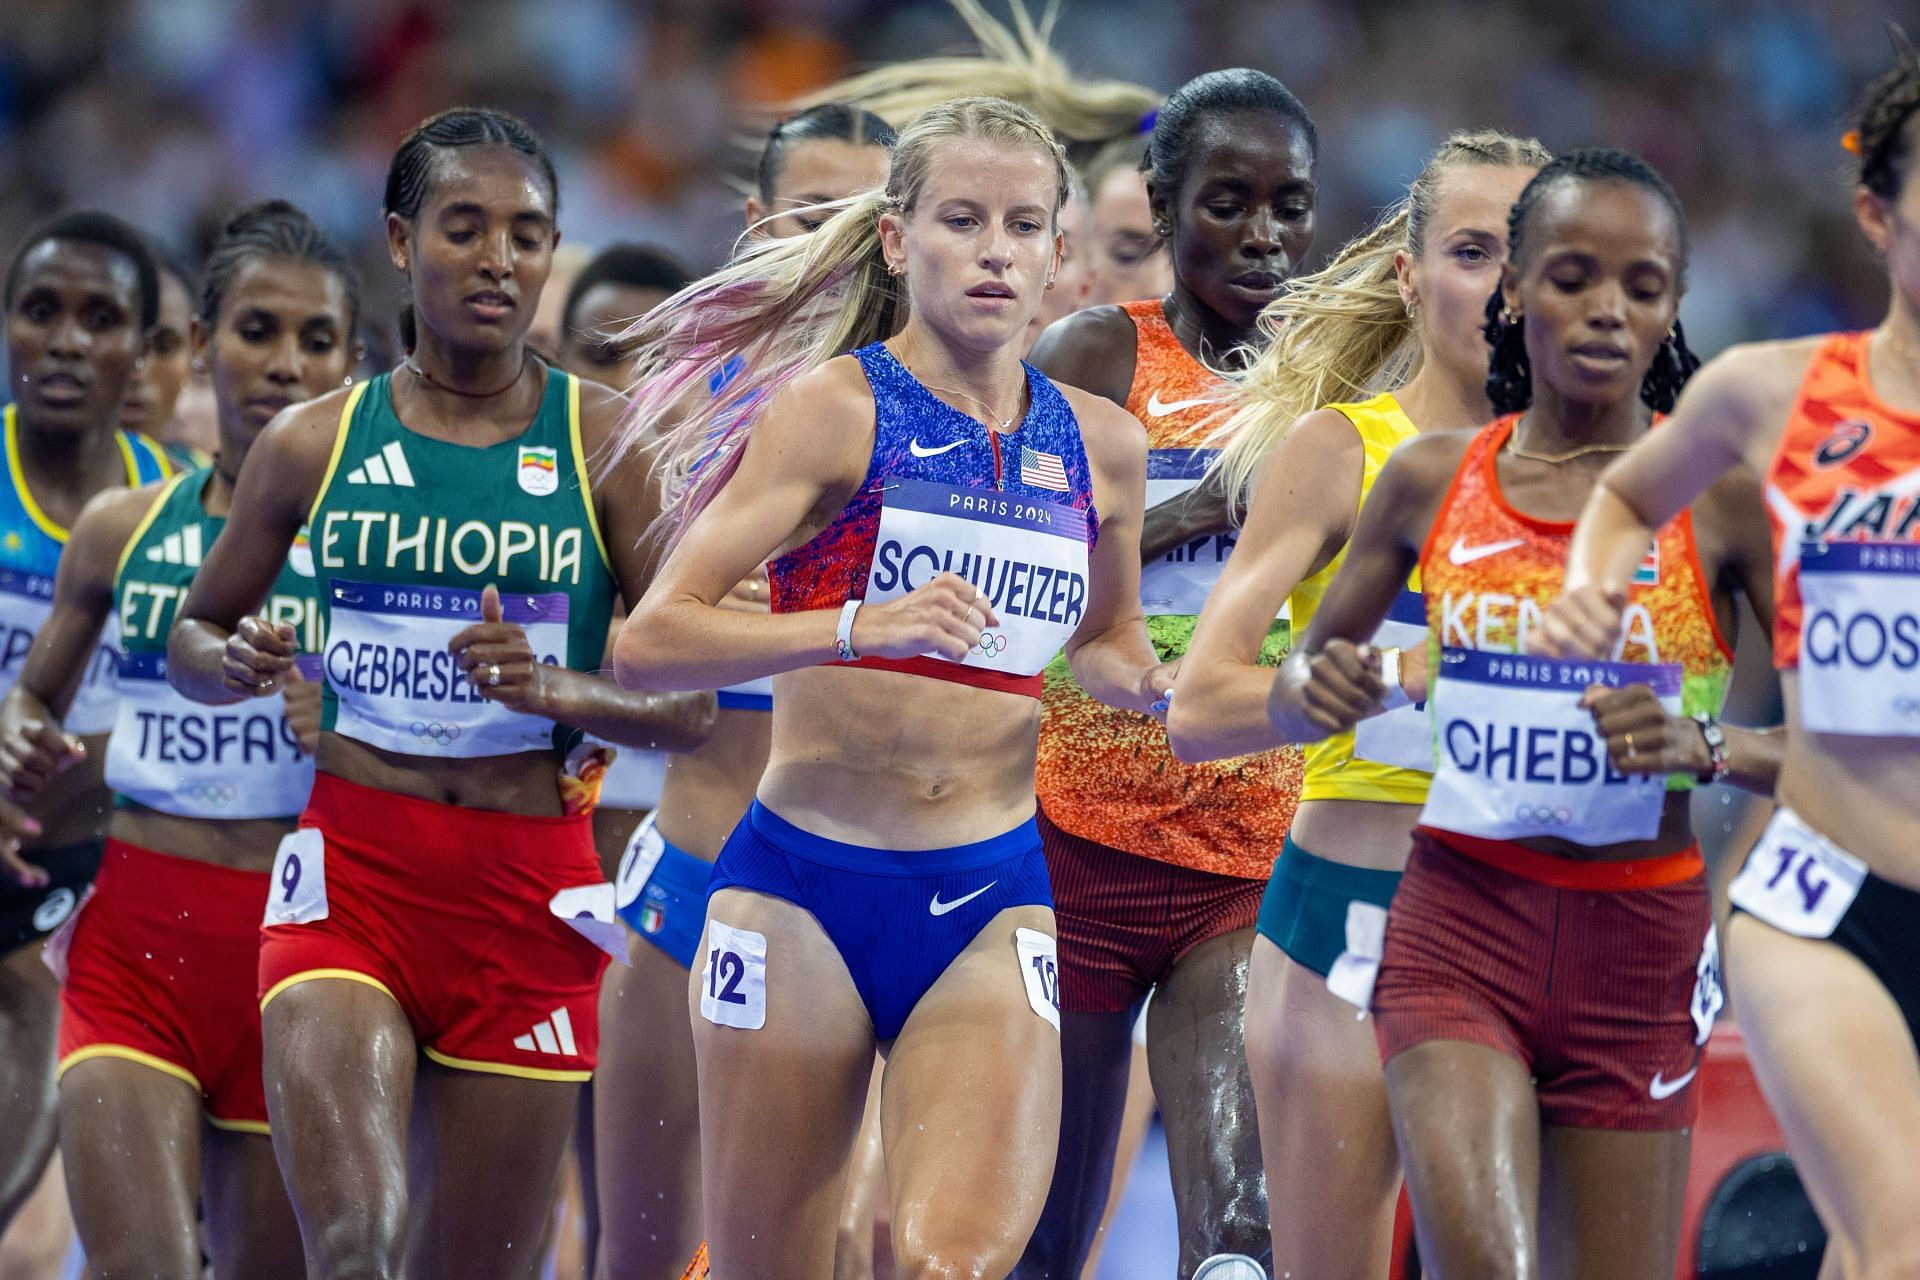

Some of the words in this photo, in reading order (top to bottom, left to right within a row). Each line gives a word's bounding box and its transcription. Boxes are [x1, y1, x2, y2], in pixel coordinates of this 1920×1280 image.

[950, 493, 1008, 516] PARIS
[1014, 504, 1051, 525] 2024
[322, 510, 582, 585] ETHIOPIA
[384, 591, 443, 610] PARIS
[1489, 660, 1552, 683] PARIS
[1560, 666, 1620, 687] 2024
[281, 853, 301, 903] 9
[1765, 847, 1830, 914] 14
[710, 948, 747, 1006] 12
